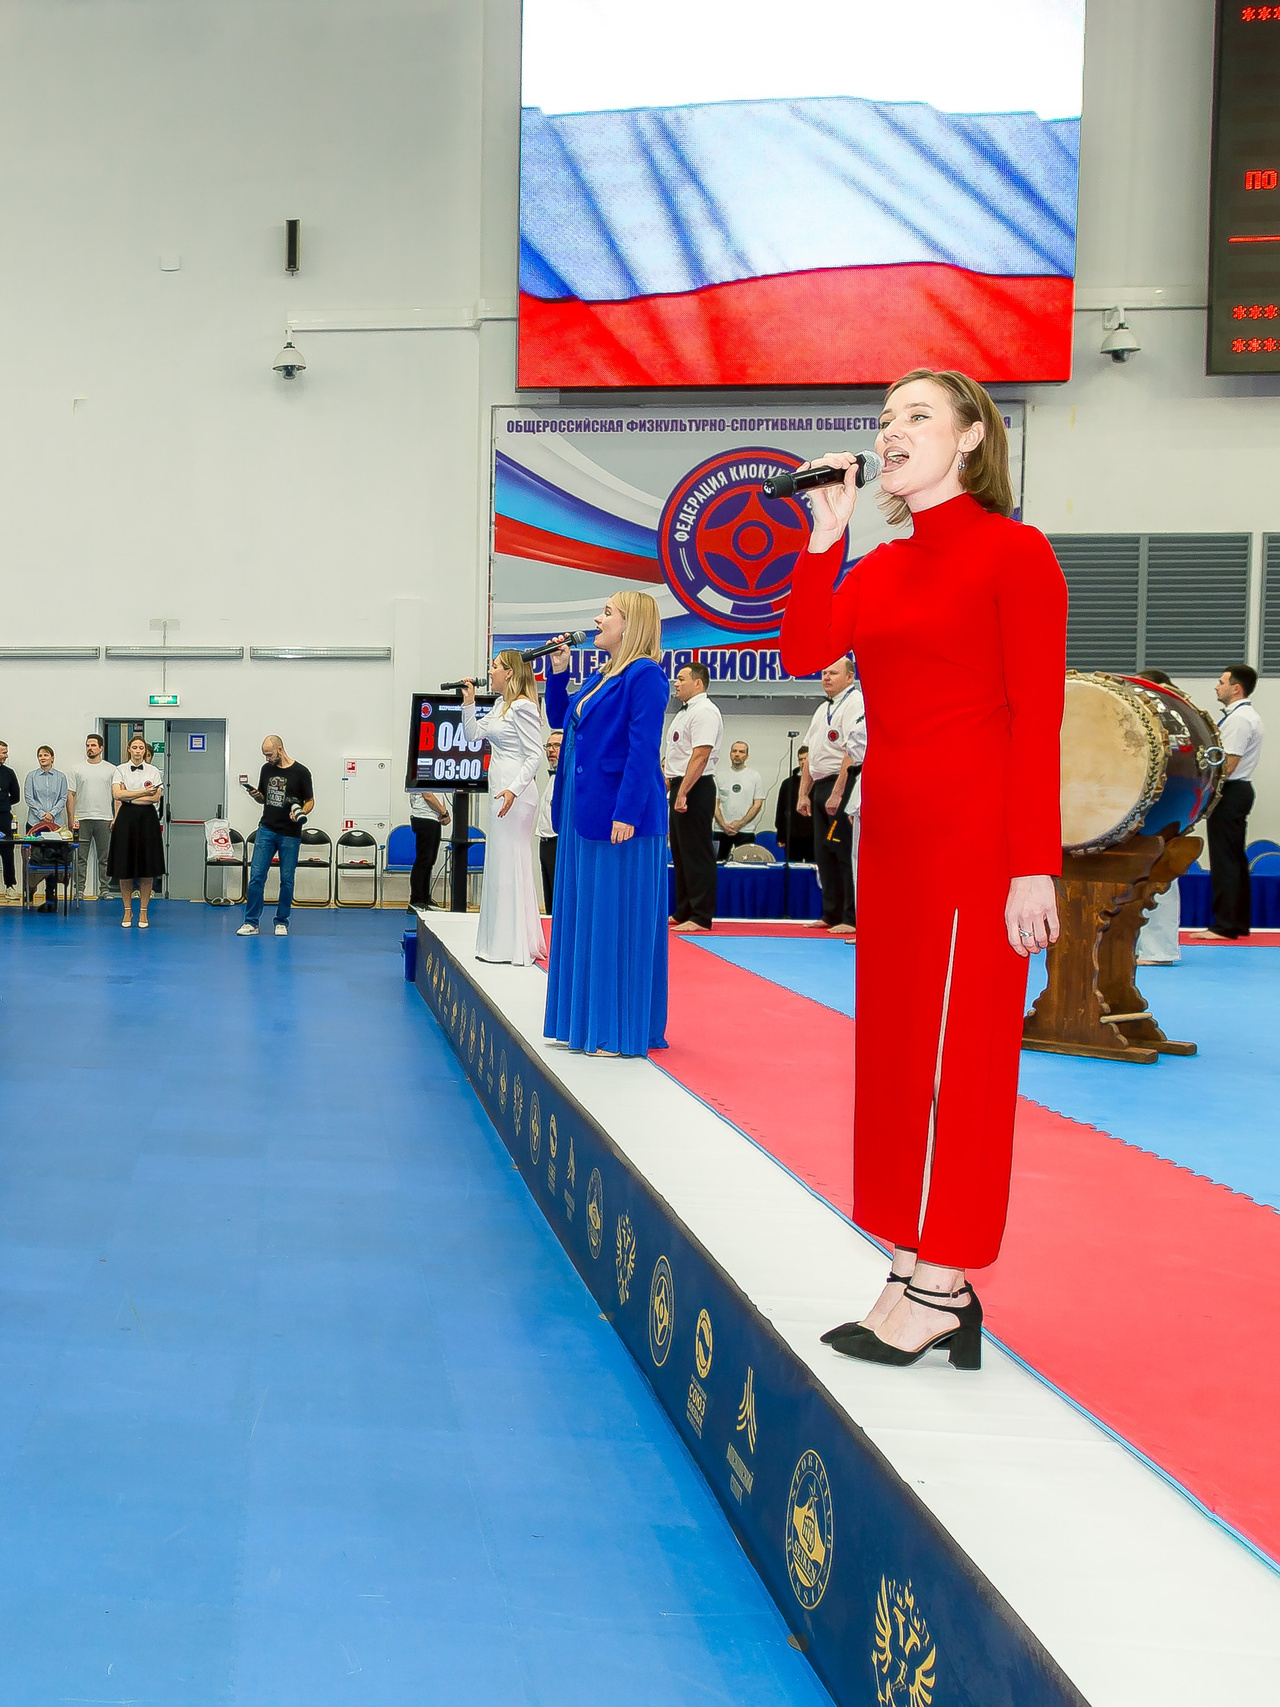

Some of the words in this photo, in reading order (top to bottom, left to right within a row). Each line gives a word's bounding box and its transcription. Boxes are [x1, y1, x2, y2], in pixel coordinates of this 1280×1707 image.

[506, 418, 624, 434] ОБЩЕРОССИЙСКАЯ
[626, 417, 813, 432] ФИЗКУЛЬТУРНО-СПОРТИВНАЯ
[816, 417, 882, 432] ОБЩЕСТВ
[674, 470, 729, 543] ФЕДЕРАЦИЯ
[729, 463, 791, 483] КИОКУ
[434, 758, 481, 780] 03:00
